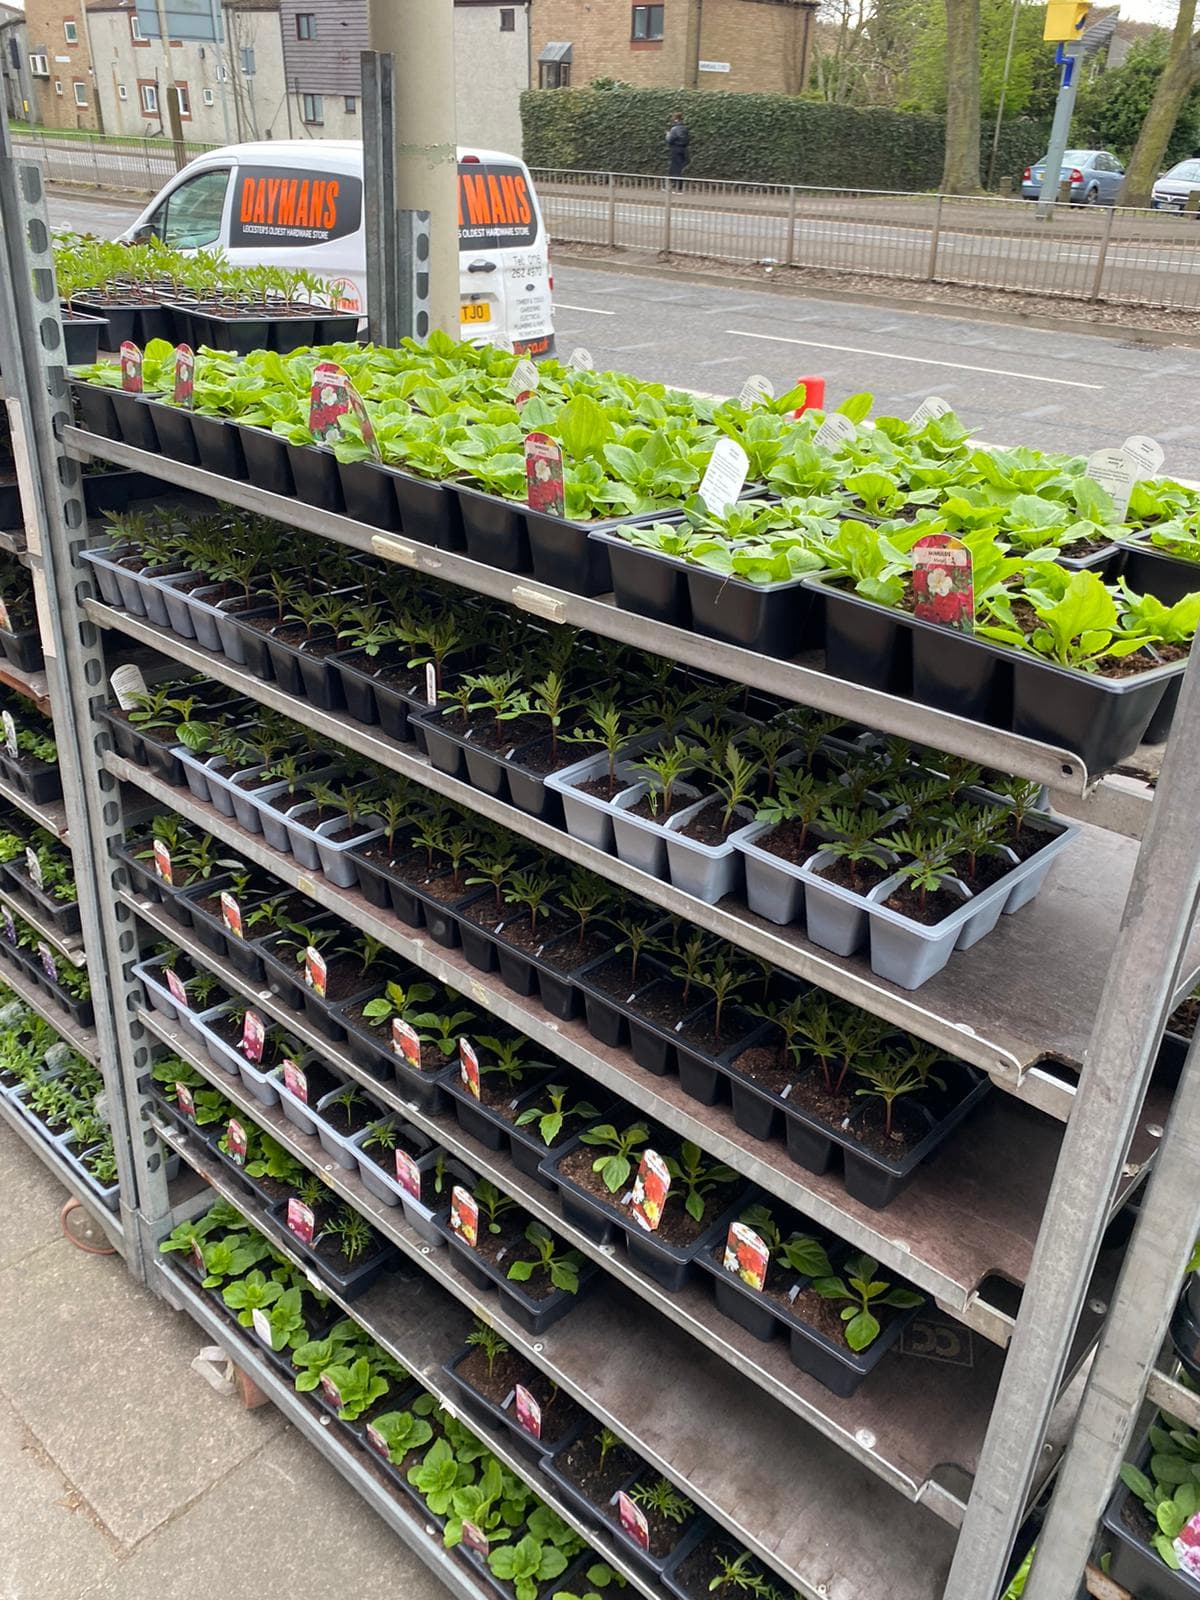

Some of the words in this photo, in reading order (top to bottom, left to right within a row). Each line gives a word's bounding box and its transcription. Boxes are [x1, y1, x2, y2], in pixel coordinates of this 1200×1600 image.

[240, 177, 339, 229] DAYMANS
[269, 227, 287, 236] OLDEST
[287, 229, 312, 238] HARDWARE
[312, 230, 329, 239] STORE
[462, 228, 485, 238] OLDEST
[485, 227, 514, 237] HARDWARE
[514, 226, 531, 236] STORE
